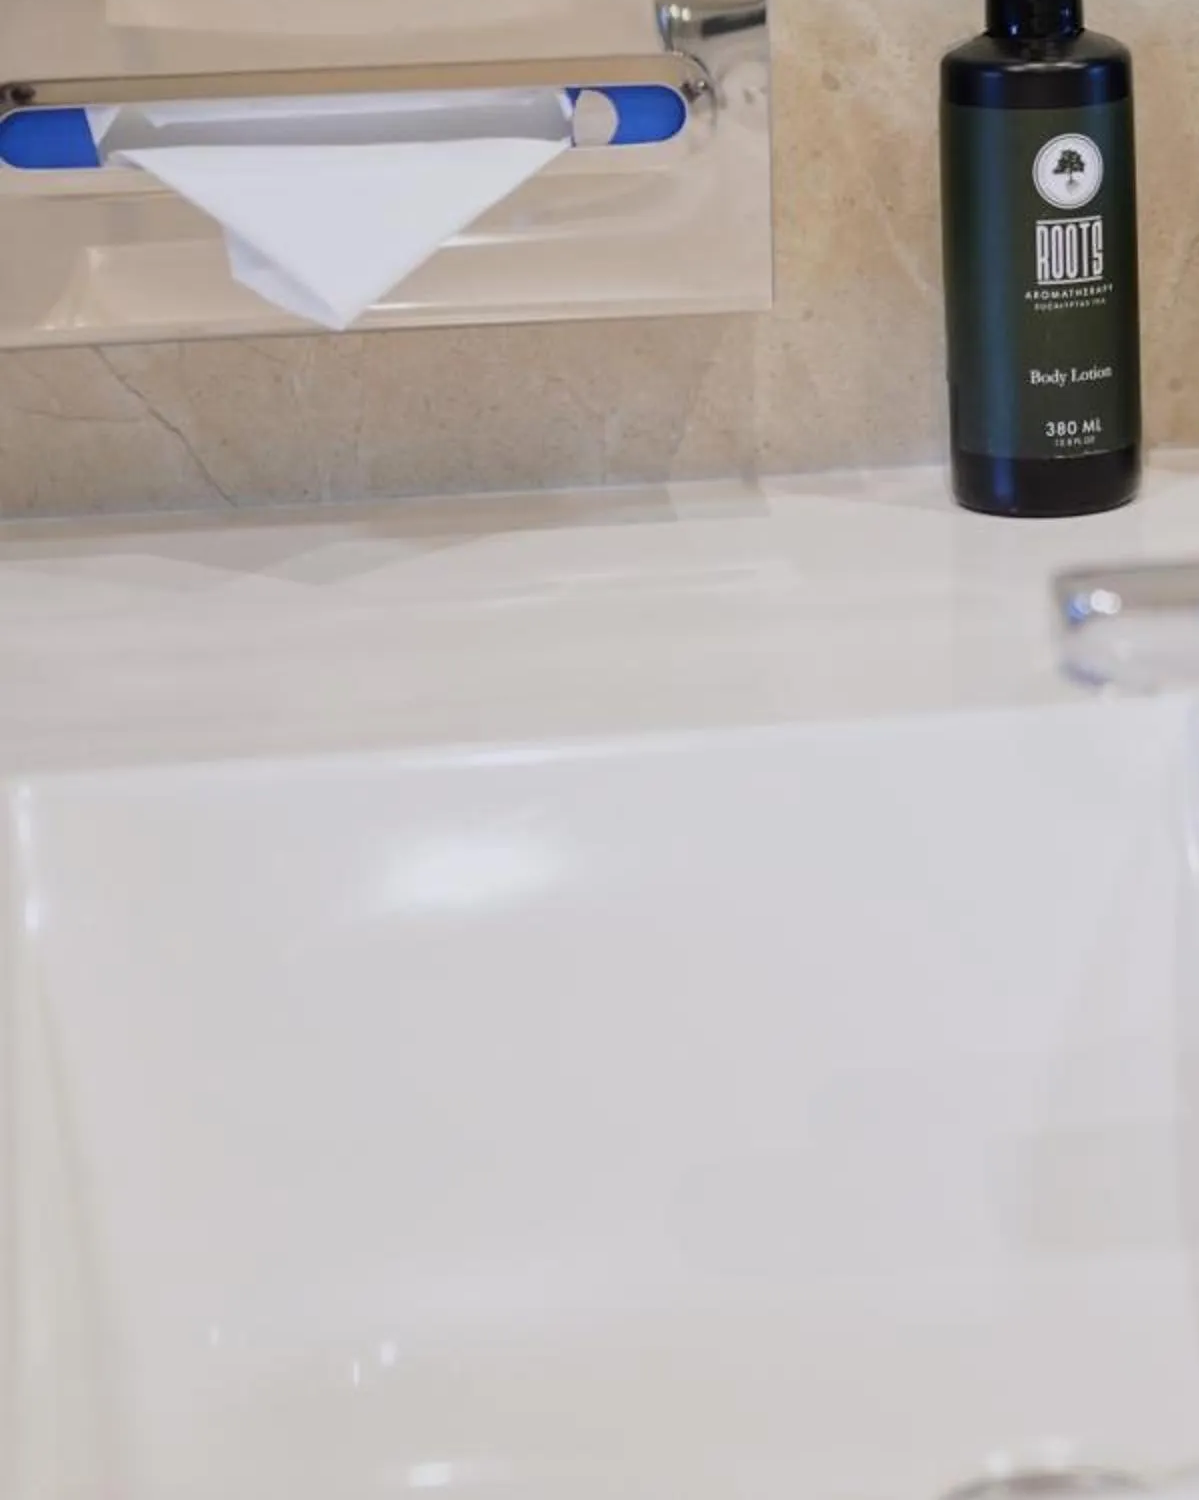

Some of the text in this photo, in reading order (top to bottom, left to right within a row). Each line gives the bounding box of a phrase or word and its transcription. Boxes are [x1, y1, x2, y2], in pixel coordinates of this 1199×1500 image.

[1036, 220, 1104, 281] ROOTS
[1024, 282, 1113, 300] AROMATHERAPY
[1029, 364, 1112, 388] Body Lotion
[1044, 421, 1077, 437] 380
